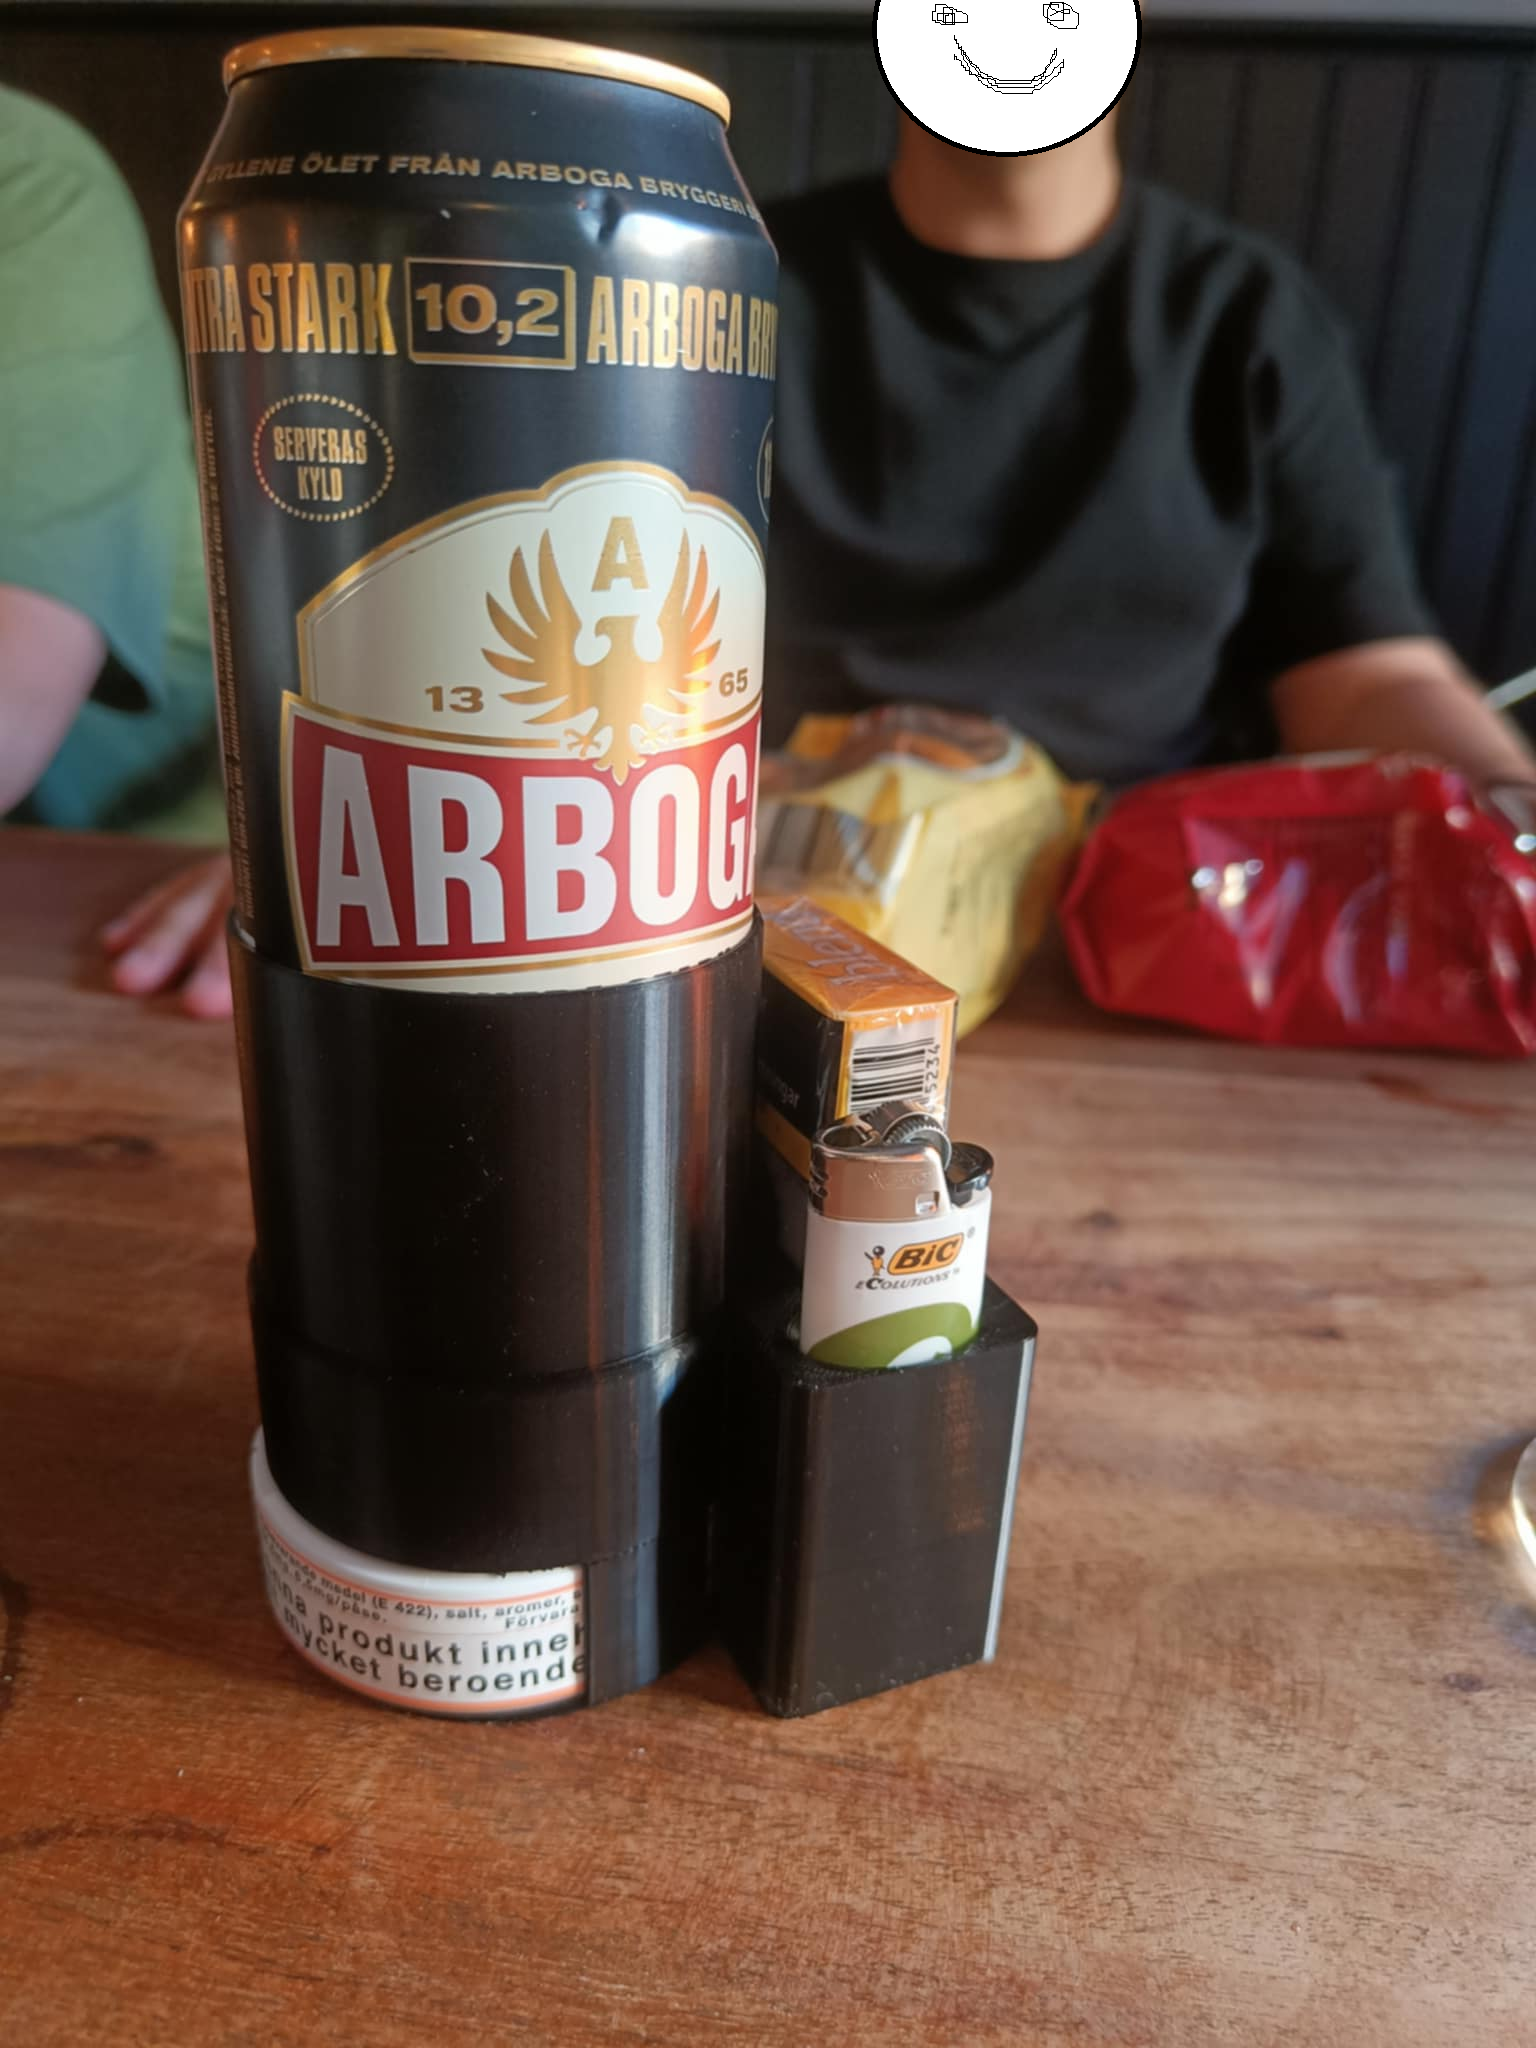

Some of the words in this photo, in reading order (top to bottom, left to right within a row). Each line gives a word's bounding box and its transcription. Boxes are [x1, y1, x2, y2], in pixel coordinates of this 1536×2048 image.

[302, 152, 380, 174] ÖLET
[388, 152, 481, 177] FRÅN
[491, 160, 633, 190] ARBOGA
[248, 262, 398, 356] STARK
[416, 283, 560, 346] 10,2
[586, 276, 743, 376] ARBOGA
[273, 426, 368, 465] SERVERAS
[298, 466, 343, 502] KYLD
[591, 516, 649, 592] A
[424, 686, 484, 714] 13
[719, 667, 749, 697] 65
[445, 1607, 488, 1621] salt,
[495, 1596, 566, 1618] aromer,
[284, 1607, 381, 1681] mycket
[319, 1611, 463, 1666] produkt
